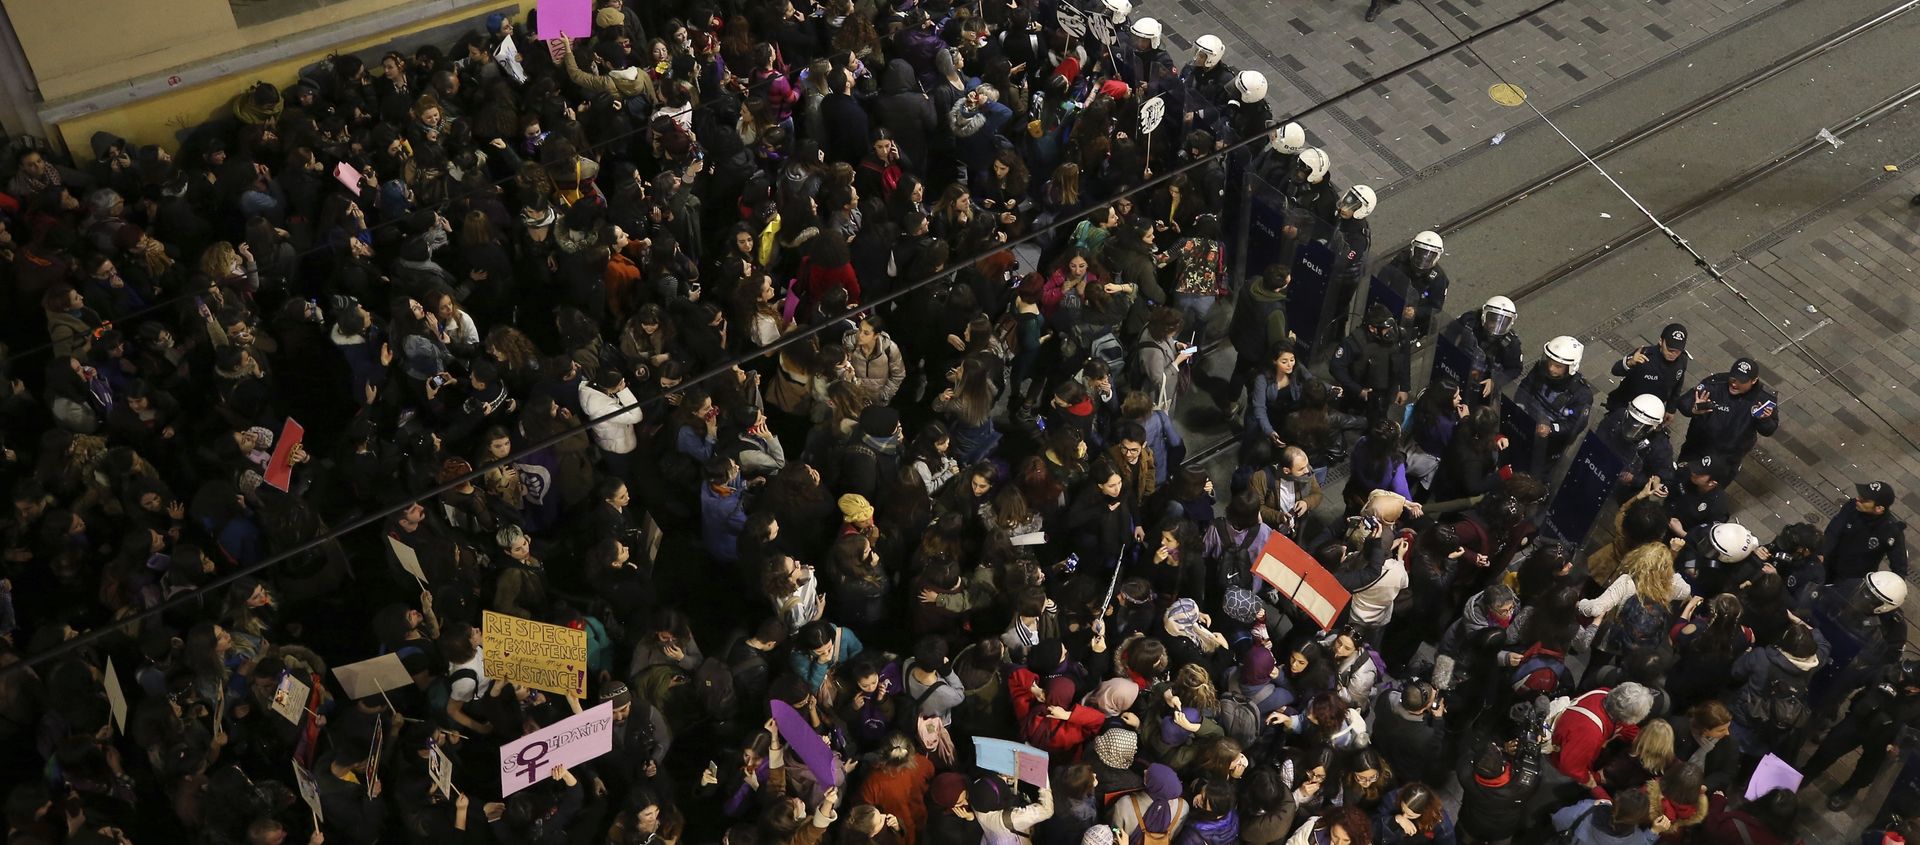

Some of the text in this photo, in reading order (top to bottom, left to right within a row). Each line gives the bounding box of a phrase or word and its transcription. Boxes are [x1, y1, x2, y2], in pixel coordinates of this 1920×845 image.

[485, 612, 583, 646] RESPECT
[485, 635, 586, 662] my EXISTENCE
